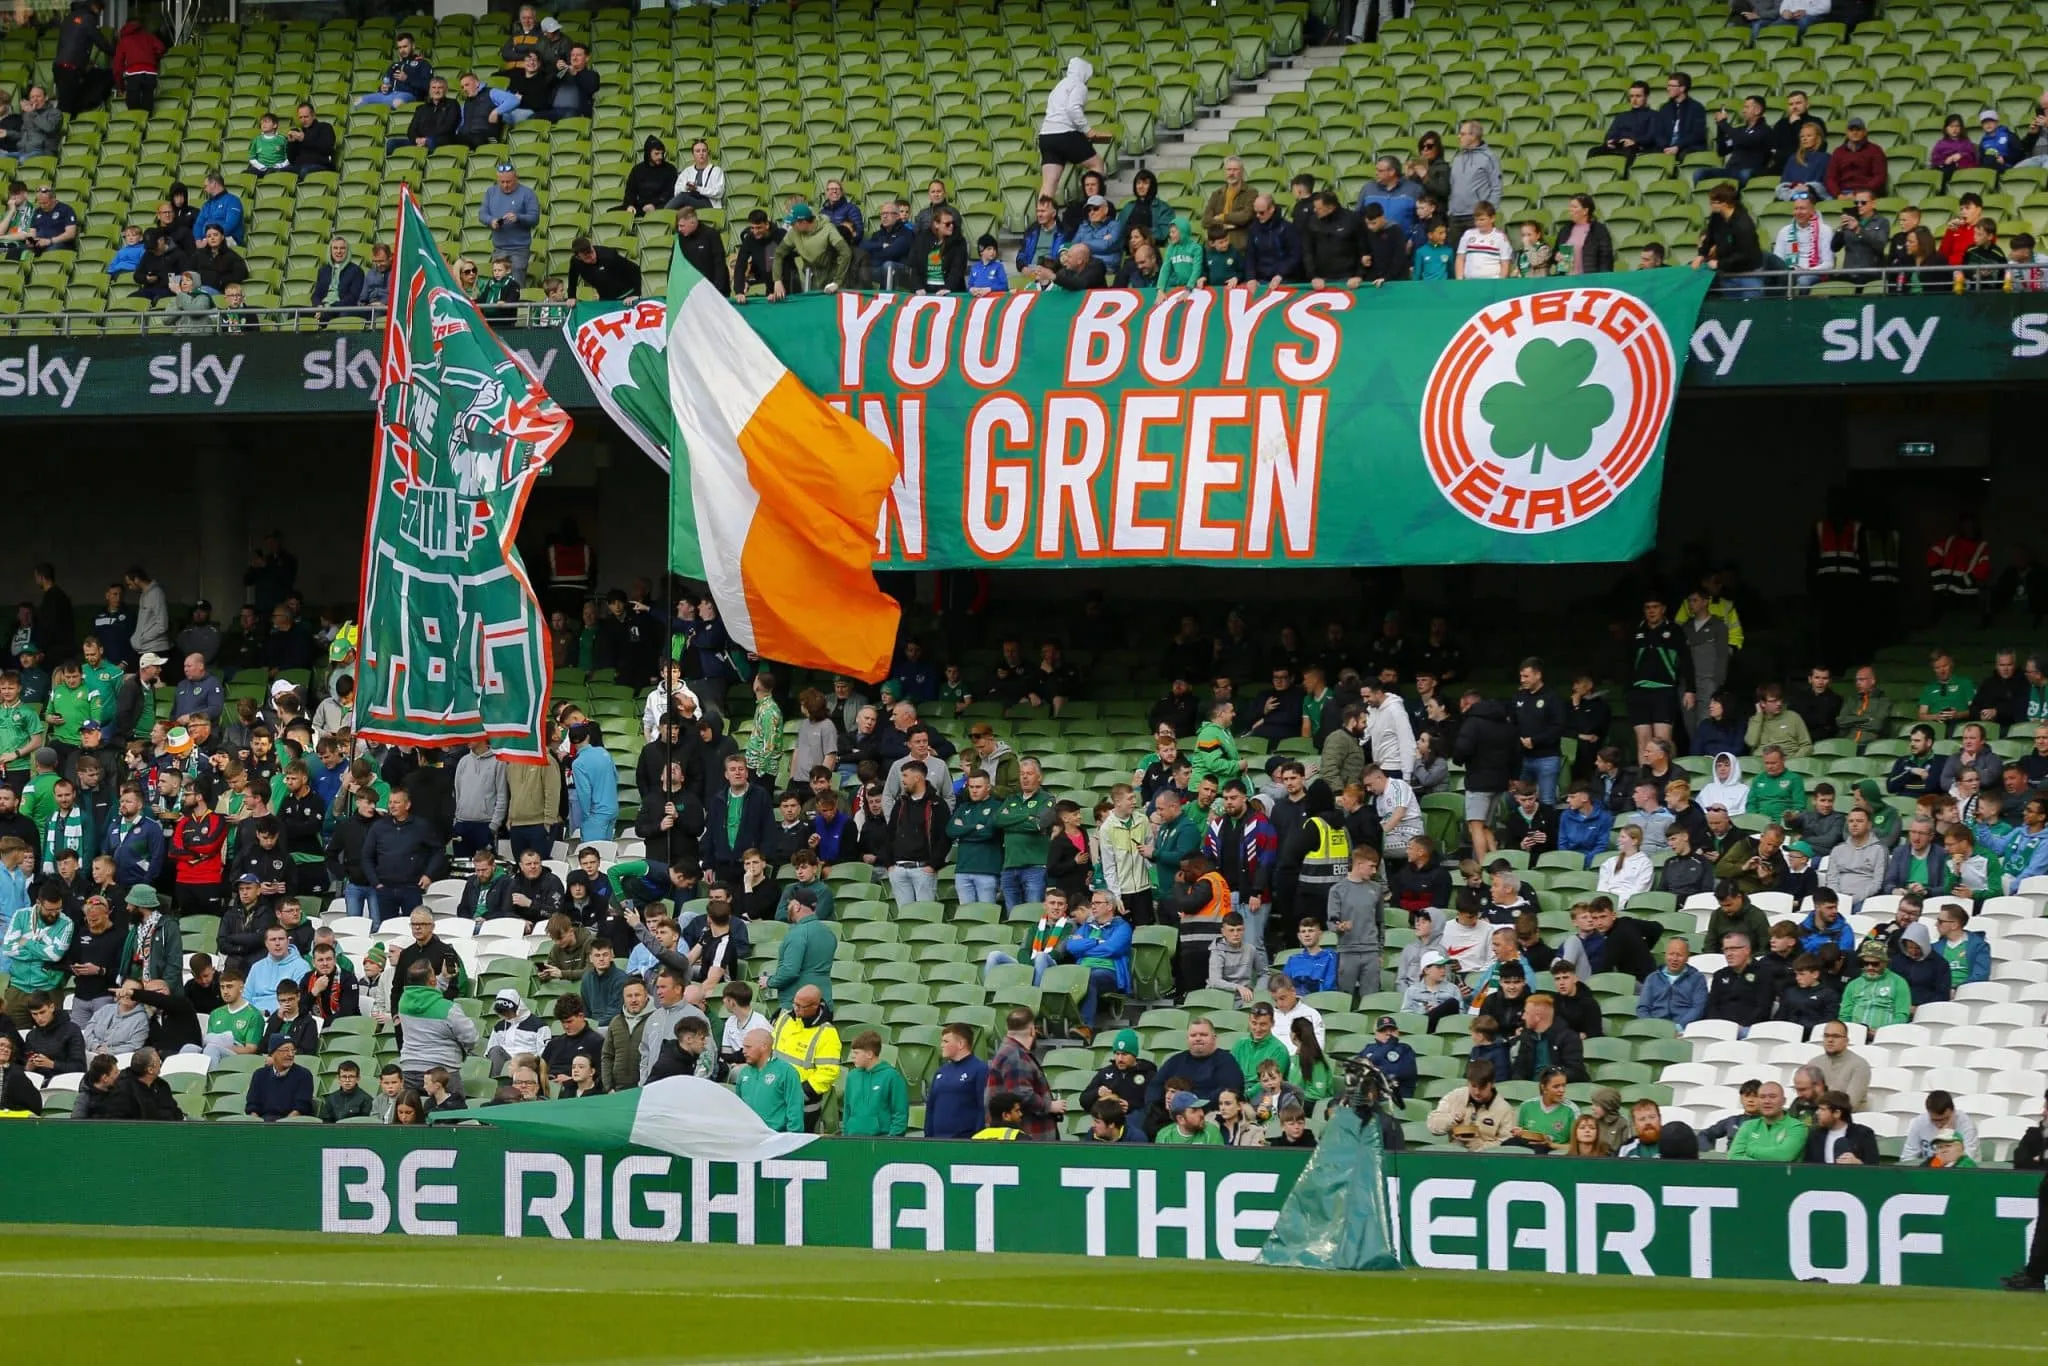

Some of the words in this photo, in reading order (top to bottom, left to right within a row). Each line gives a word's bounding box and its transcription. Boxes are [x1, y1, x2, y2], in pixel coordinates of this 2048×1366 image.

[836, 290, 1038, 390] YOU
[1064, 286, 1358, 388] BOYS
[1478, 290, 1649, 345] YBIG
[1822, 304, 1941, 374] sky
[0, 344, 91, 408] sky
[149, 342, 244, 406] sky
[820, 393, 927, 561] N
[962, 389, 1331, 560] GREEN
[322, 1148, 457, 1236] BE
[505, 1151, 828, 1247] RIGHT
[872, 1162, 1019, 1253] AT
[1060, 1168, 1281, 1262] THE
[1387, 1176, 1739, 1278] EART
[1788, 1190, 1949, 1286] OF
